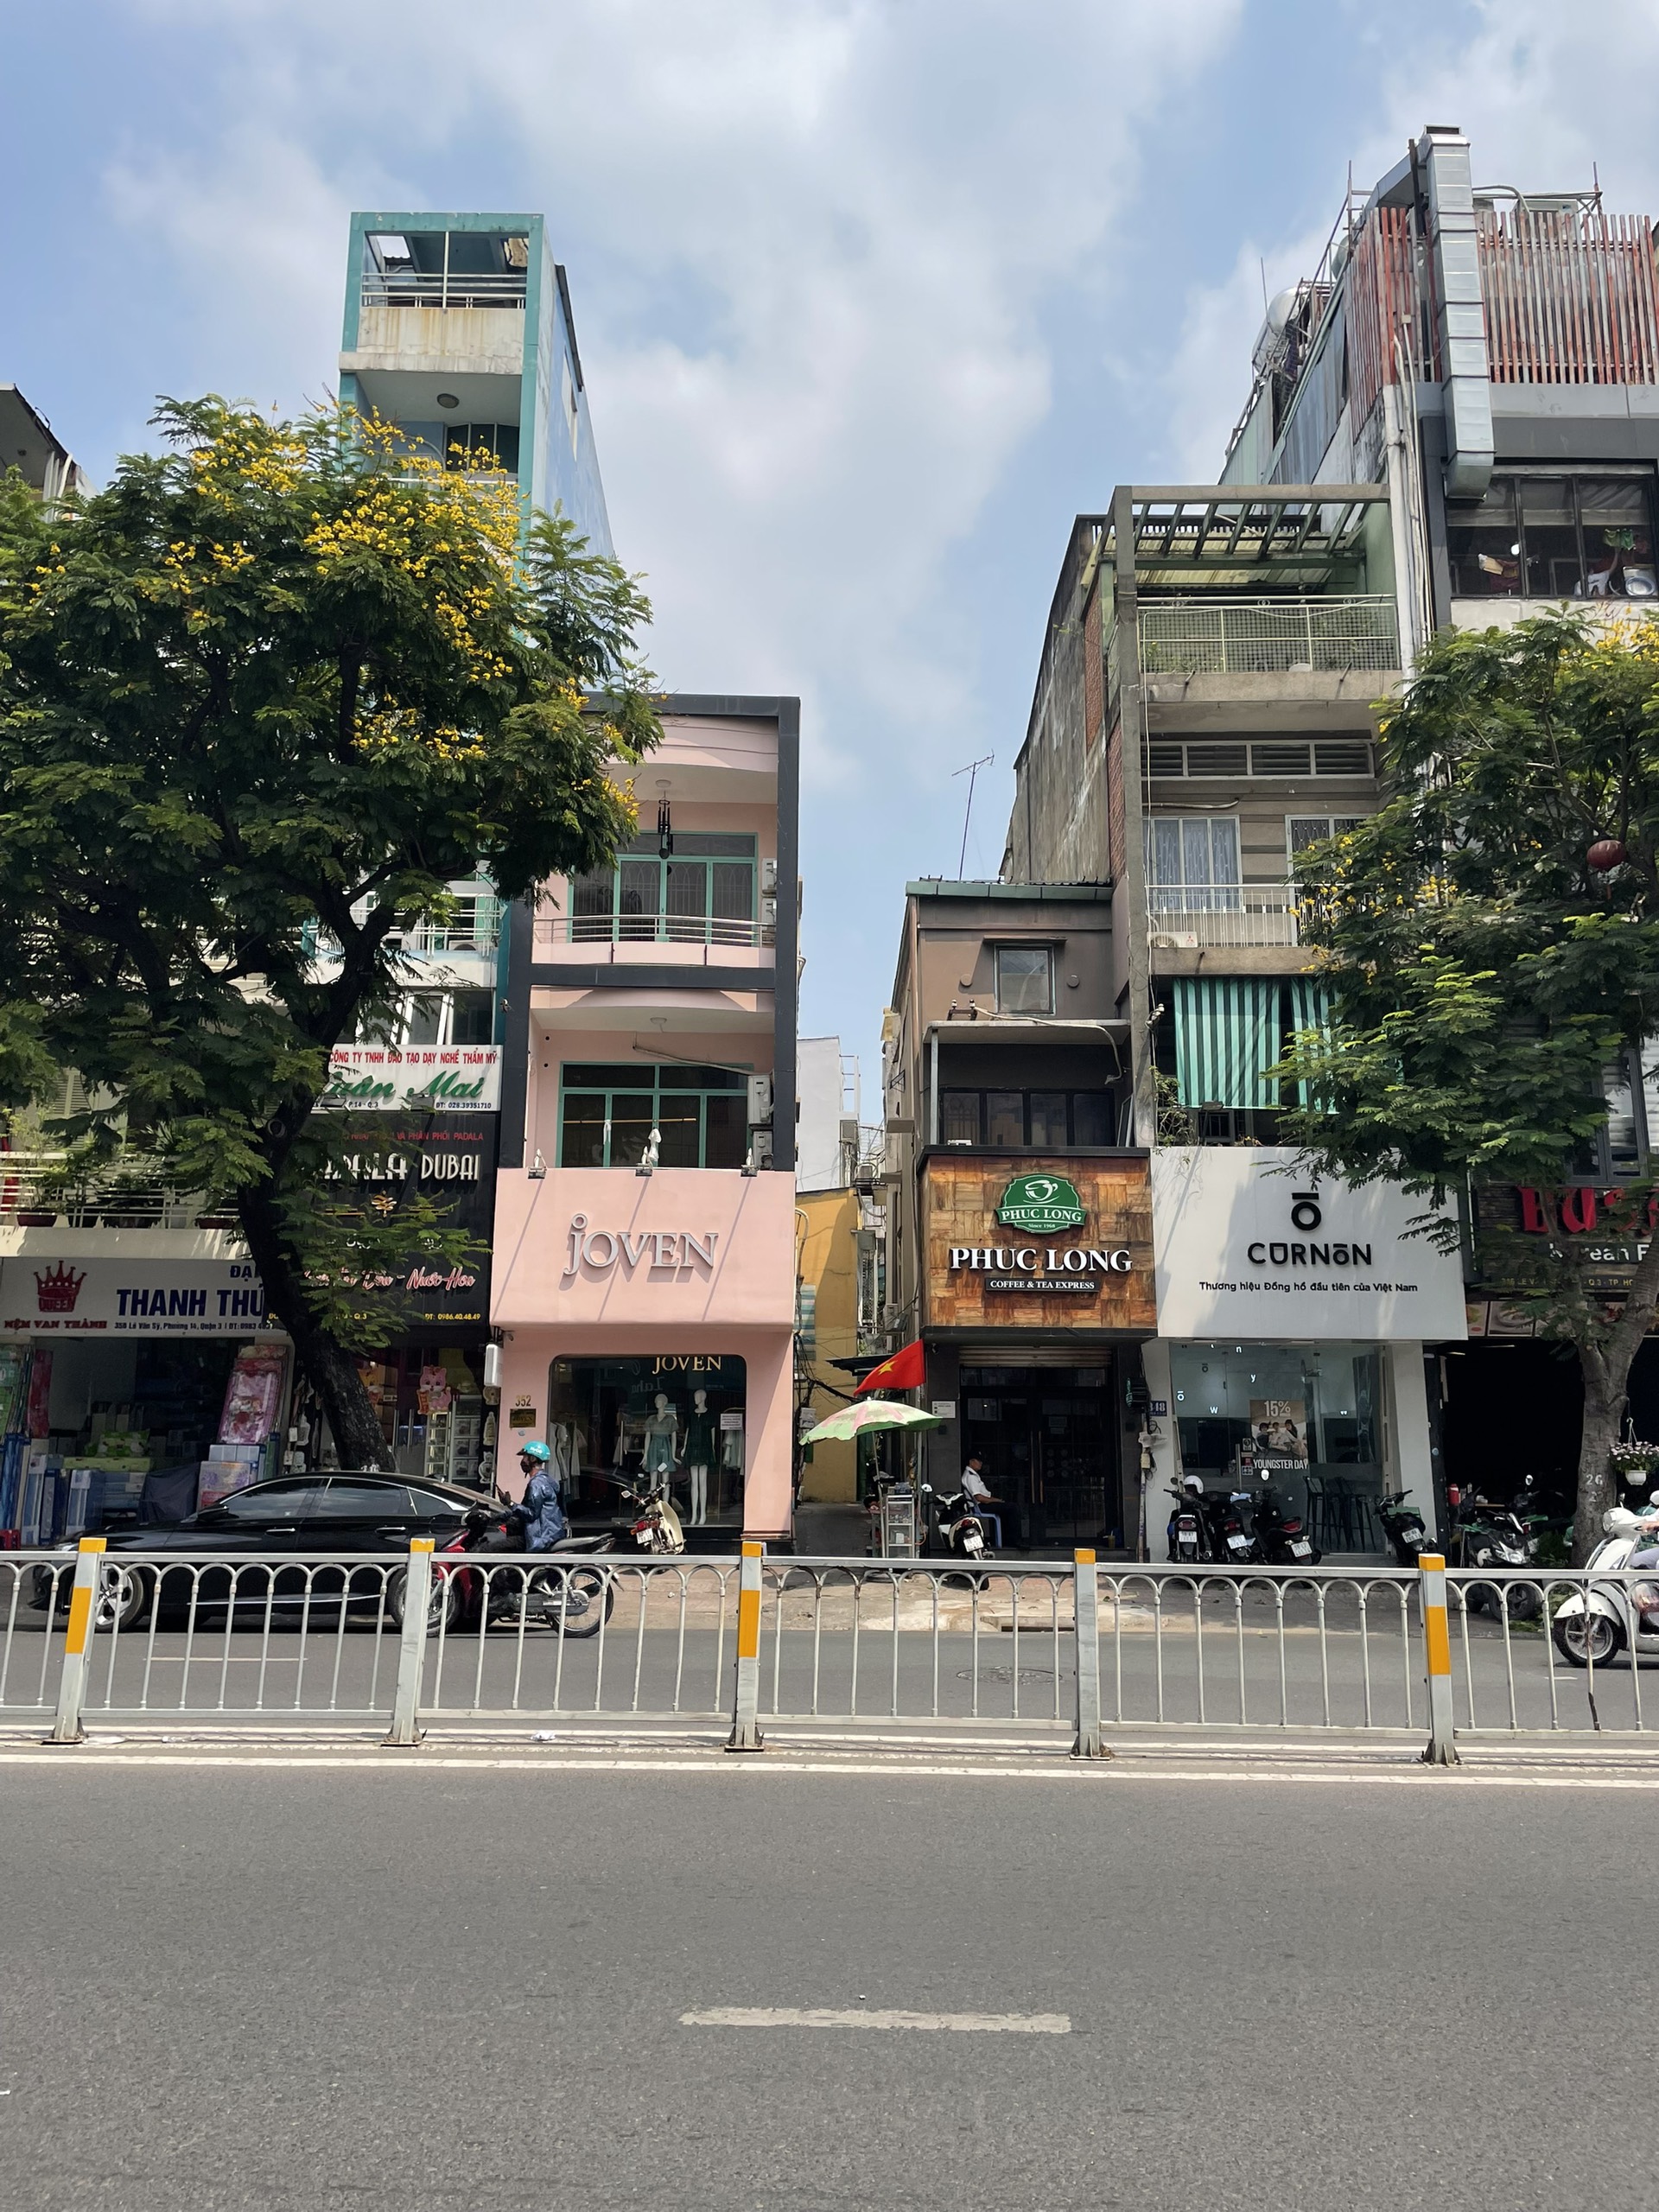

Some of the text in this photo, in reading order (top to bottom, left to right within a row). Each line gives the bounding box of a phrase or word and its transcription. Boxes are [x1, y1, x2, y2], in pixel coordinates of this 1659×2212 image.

[353, 1052, 362, 1064] TY
[365, 1052, 385, 1064] TNHH
[406, 1052, 420, 1066] TẠO
[423, 1052, 437, 1066] DẠY
[407, 1071, 486, 1098] Mai
[453, 1132, 484, 1141] PADALA
[421, 1154, 480, 1180] DUBAI
[1001, 1209, 1083, 1222] PHUC LONG
[950, 1248, 1133, 1272] PHUC LONG
[990, 1280, 1026, 1288] COFFEE
[1027, 1280, 1034, 1288] &
[1055, 1281, 1095, 1290] EXPRESS
[1198, 1281, 1237, 1293] Thương
[1239, 1281, 1261, 1292] hiệu
[1264, 1281, 1291, 1294] Đồng
[1332, 1281, 1351, 1292] tiên
[1353, 1281, 1371, 1293] của
[1373, 1282, 1393, 1294] Việt
[1395, 1283, 1418, 1293] Nam
[116, 1288, 207, 1317] THANH
[515, 1395, 531, 1407] 352
[1264, 1401, 1291, 1417] 15%
[1253, 1459, 1294, 1469] YOUNGSTER
[1294, 1459, 1309, 1469] DAY
